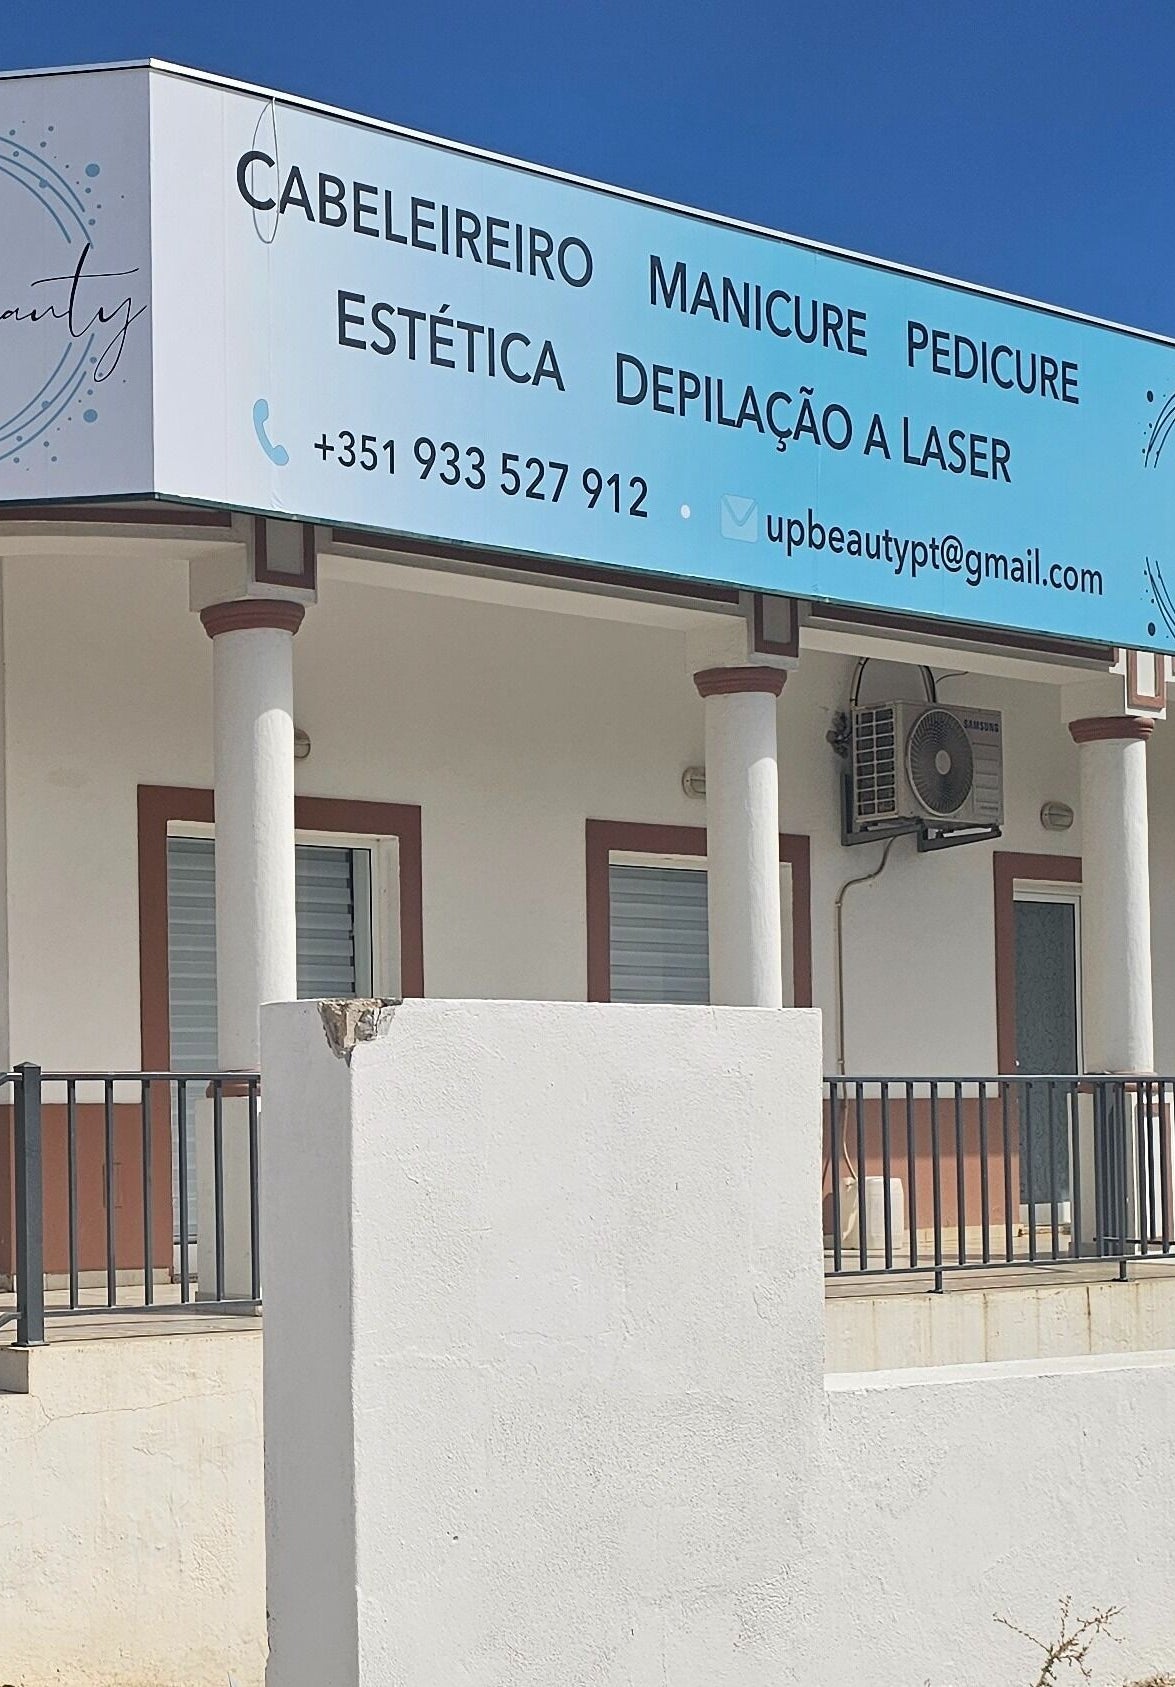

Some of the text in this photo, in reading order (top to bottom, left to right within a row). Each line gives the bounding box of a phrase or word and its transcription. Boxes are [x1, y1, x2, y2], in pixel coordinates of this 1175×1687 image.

[236, 150, 593, 288] CABELEIREIRO
[649, 254, 1080, 404] MANICURE PEDICURE
[337, 290, 1012, 483] ESTÉTICA DEPILAÇÃO A LASER
[314, 430, 648, 518] +351 933 527 912
[766, 508, 1104, 596] upbeautypt@gmail.com
[964, 719, 999, 733] SAMSUNG
